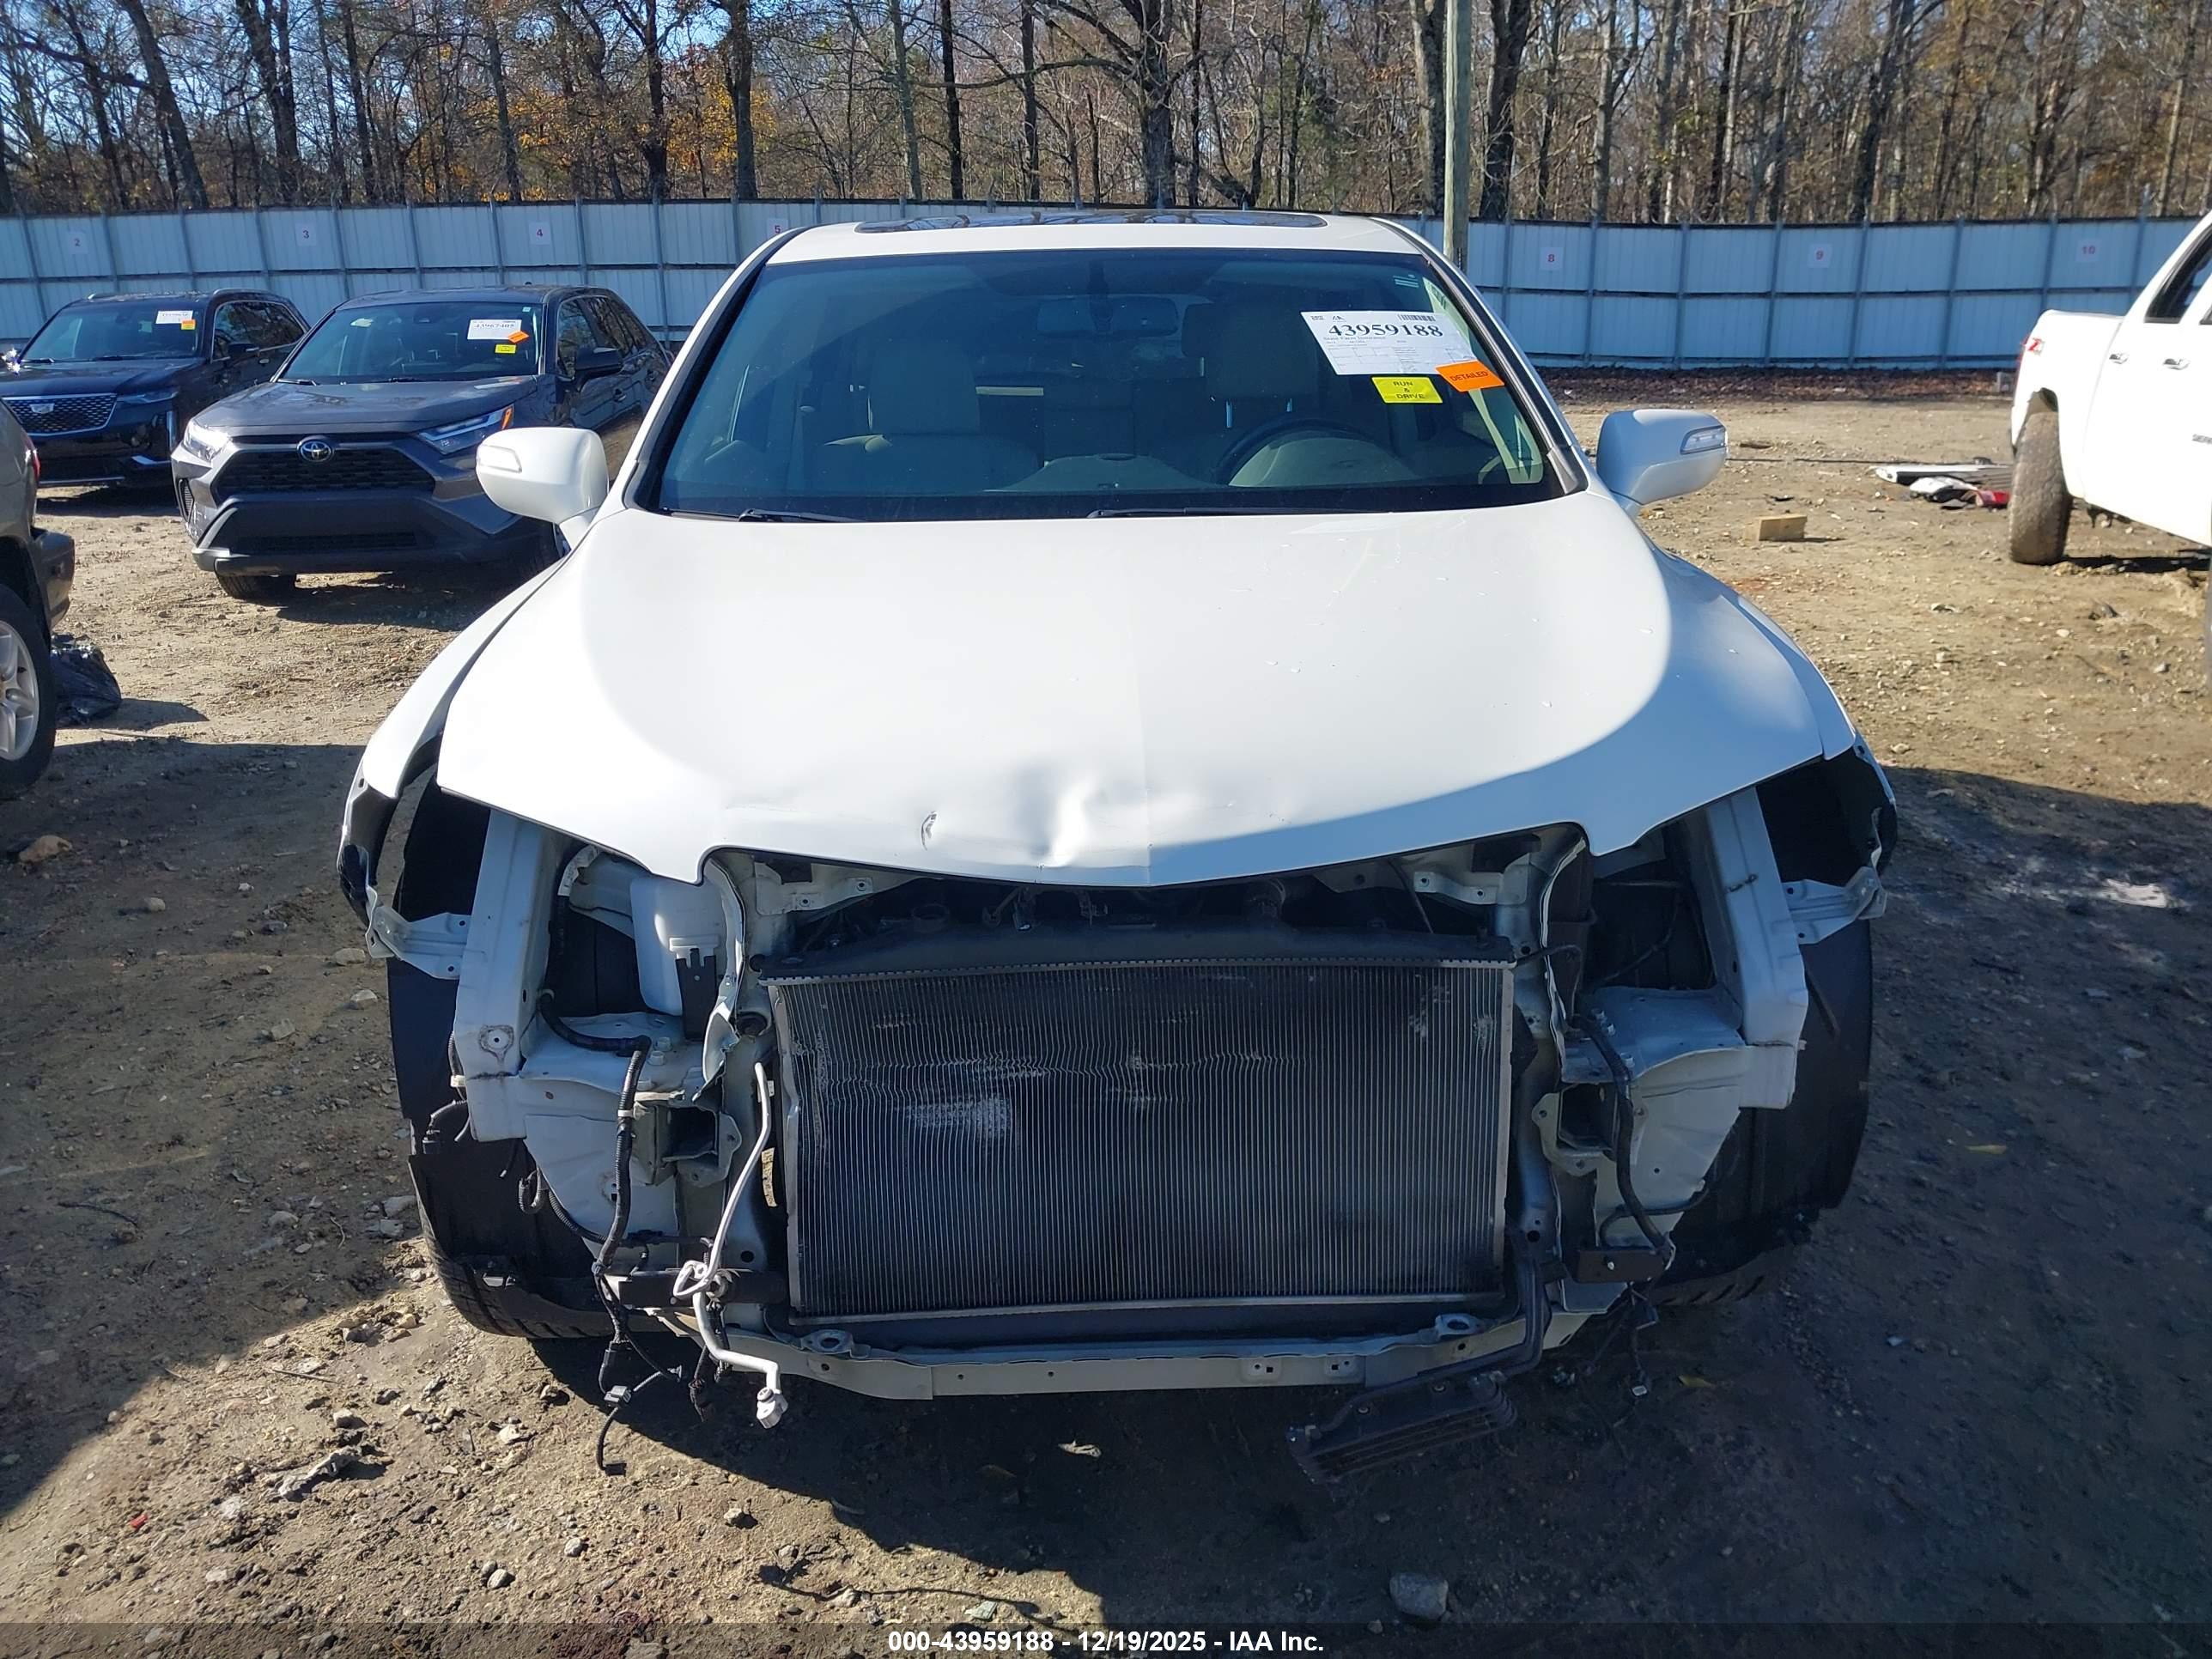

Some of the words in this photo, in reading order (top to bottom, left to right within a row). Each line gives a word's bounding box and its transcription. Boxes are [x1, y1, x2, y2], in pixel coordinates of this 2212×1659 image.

[302, 229, 310, 239] 3
[74, 238, 81, 246] 2
[1815, 250, 1824, 261] 9
[2081, 246, 2096, 255] 10
[1547, 253, 1555, 262] 8
[1328, 324, 1443, 337] 43959188
[1449, 370, 1489, 382] DETAILED
